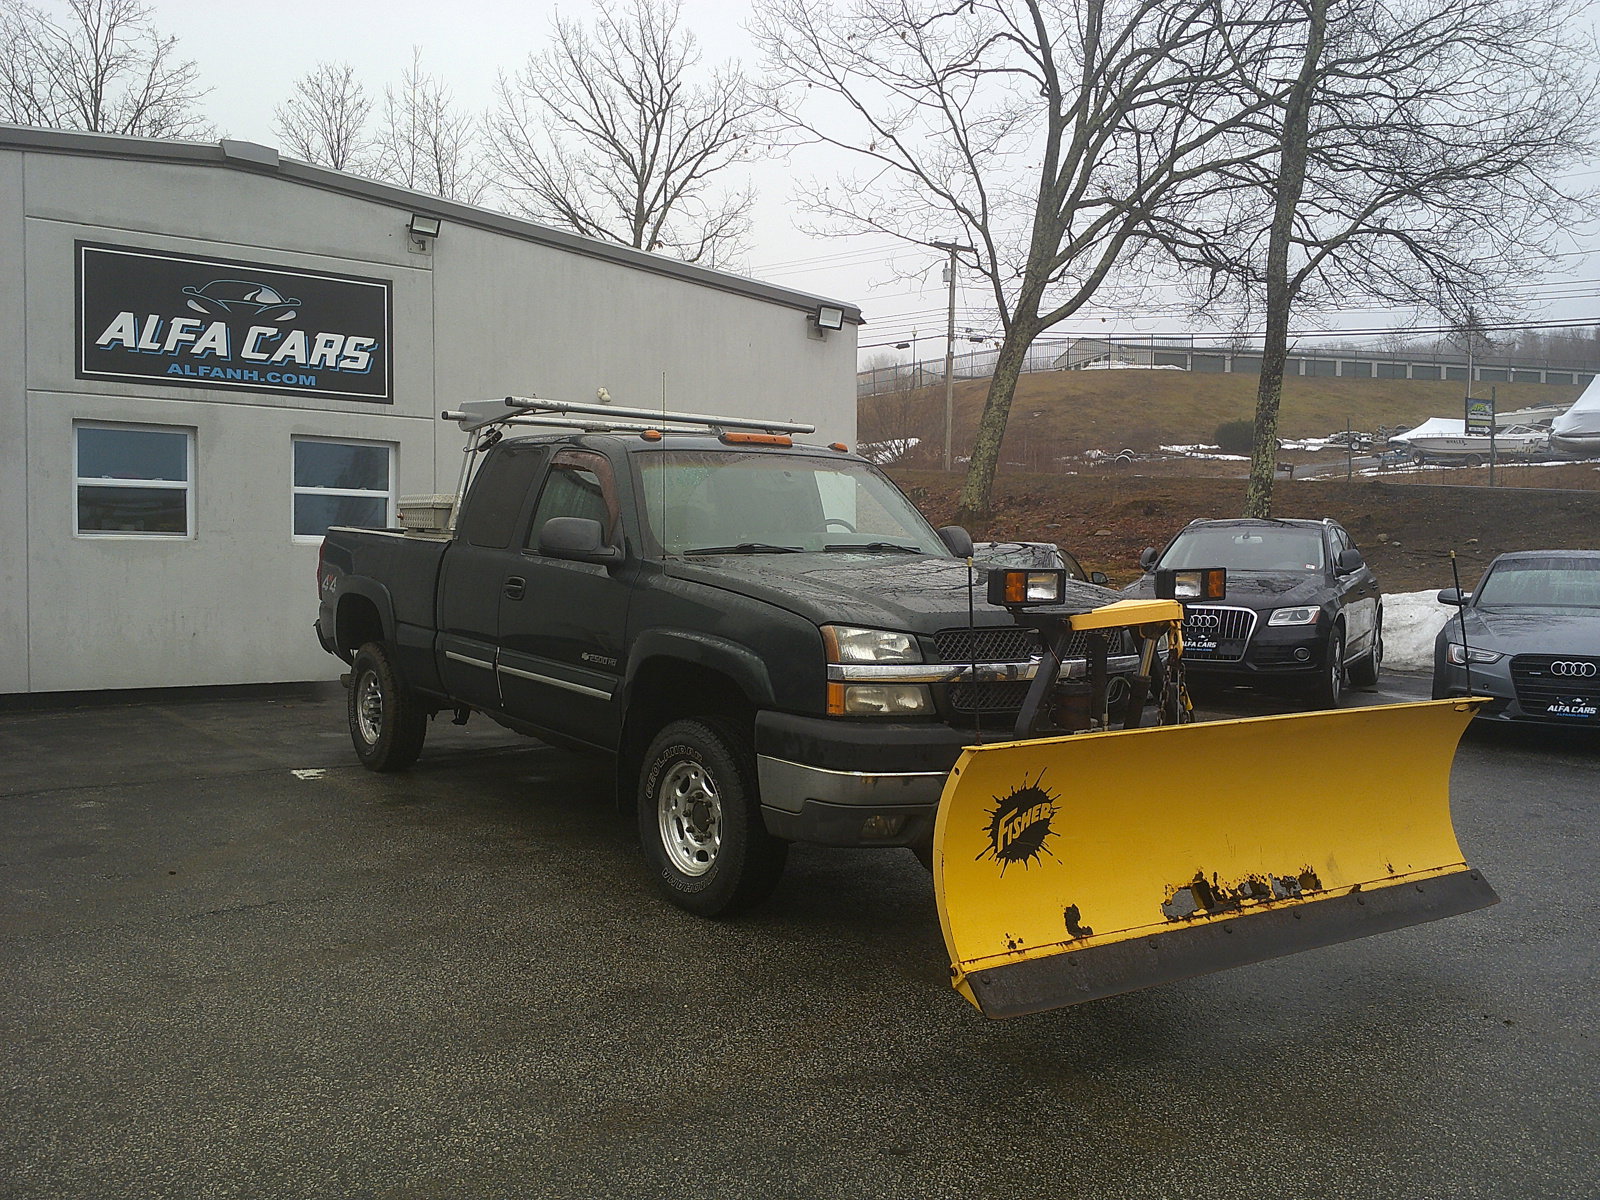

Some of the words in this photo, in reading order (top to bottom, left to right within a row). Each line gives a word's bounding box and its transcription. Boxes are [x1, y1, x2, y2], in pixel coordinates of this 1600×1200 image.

[95, 311, 231, 361] ALFA
[241, 325, 378, 374] CARS
[167, 363, 316, 386] ALFANH.COM
[1547, 705, 1570, 713] ALFA
[1571, 706, 1597, 715] CARS
[997, 802, 1053, 854] FISHER
